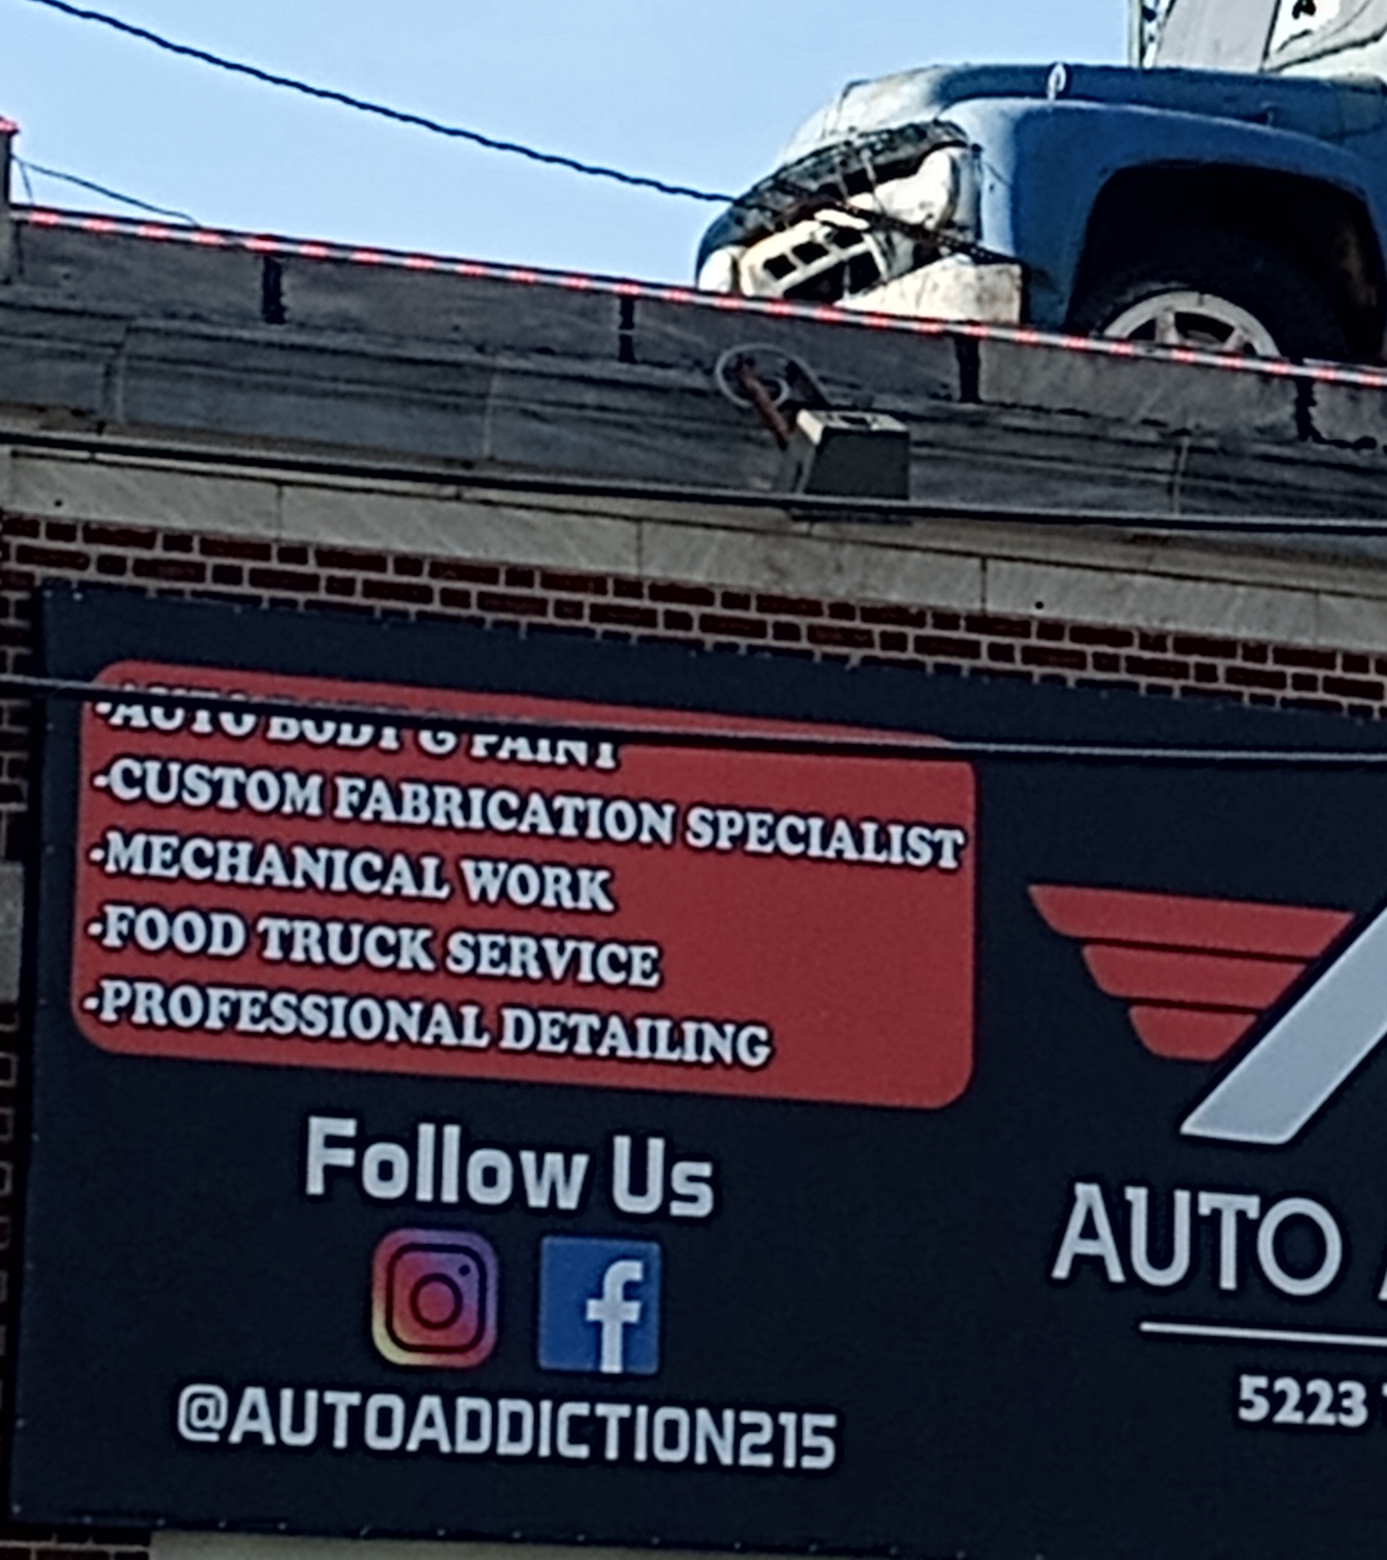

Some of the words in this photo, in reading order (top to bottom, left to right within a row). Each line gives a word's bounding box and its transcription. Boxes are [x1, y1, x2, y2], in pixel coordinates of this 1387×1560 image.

[334, 777, 675, 844] FABRICATION
[686, 807, 965, 869] SPECIALIST
[460, 860, 614, 911] WORK
[257, 917, 435, 970] TRUCK
[446, 932, 660, 987] SERVICE
[499, 1008, 771, 1066] DETAILING
[307, 1116, 589, 1210] Follow
[613, 1135, 713, 1217] Us
[1052, 1182, 1342, 1295] AUTO
[178, 1384, 836, 1469] @AUTOADDICTION215
[1239, 1374, 1368, 1427] 5223
